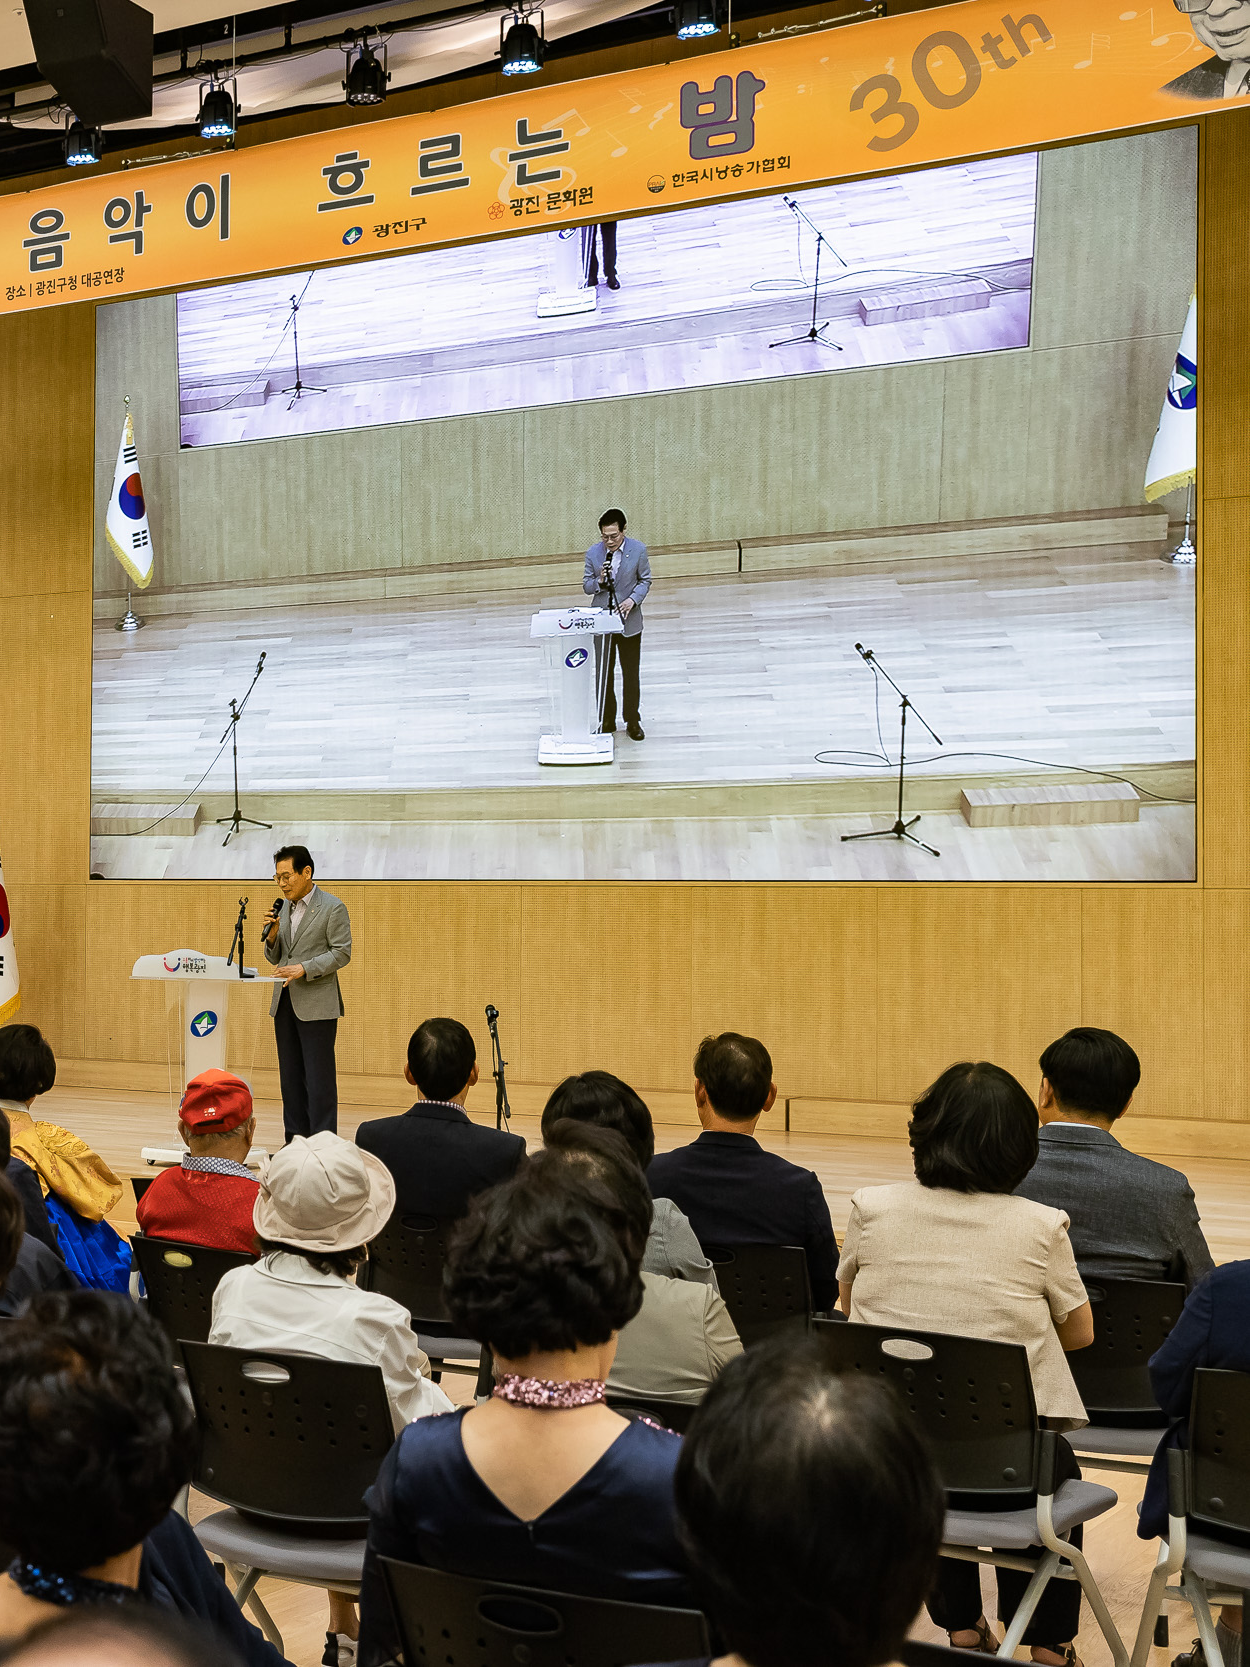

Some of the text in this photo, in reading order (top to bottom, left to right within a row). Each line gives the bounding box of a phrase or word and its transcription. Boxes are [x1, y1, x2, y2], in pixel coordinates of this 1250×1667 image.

[850, 13, 1053, 152] 30th
[22, 173, 232, 273] 음악이
[316, 117, 571, 213] 흐르는
[678, 70, 766, 160] 밤
[671, 155, 791, 188] 한국시낭송가협회
[509, 186, 593, 217] 광진 문화원
[372, 217, 427, 238] 광진구
[5, 285, 27, 301] 장소
[35, 275, 77, 296] 광진구청
[81, 267, 125, 288] 대공연장
